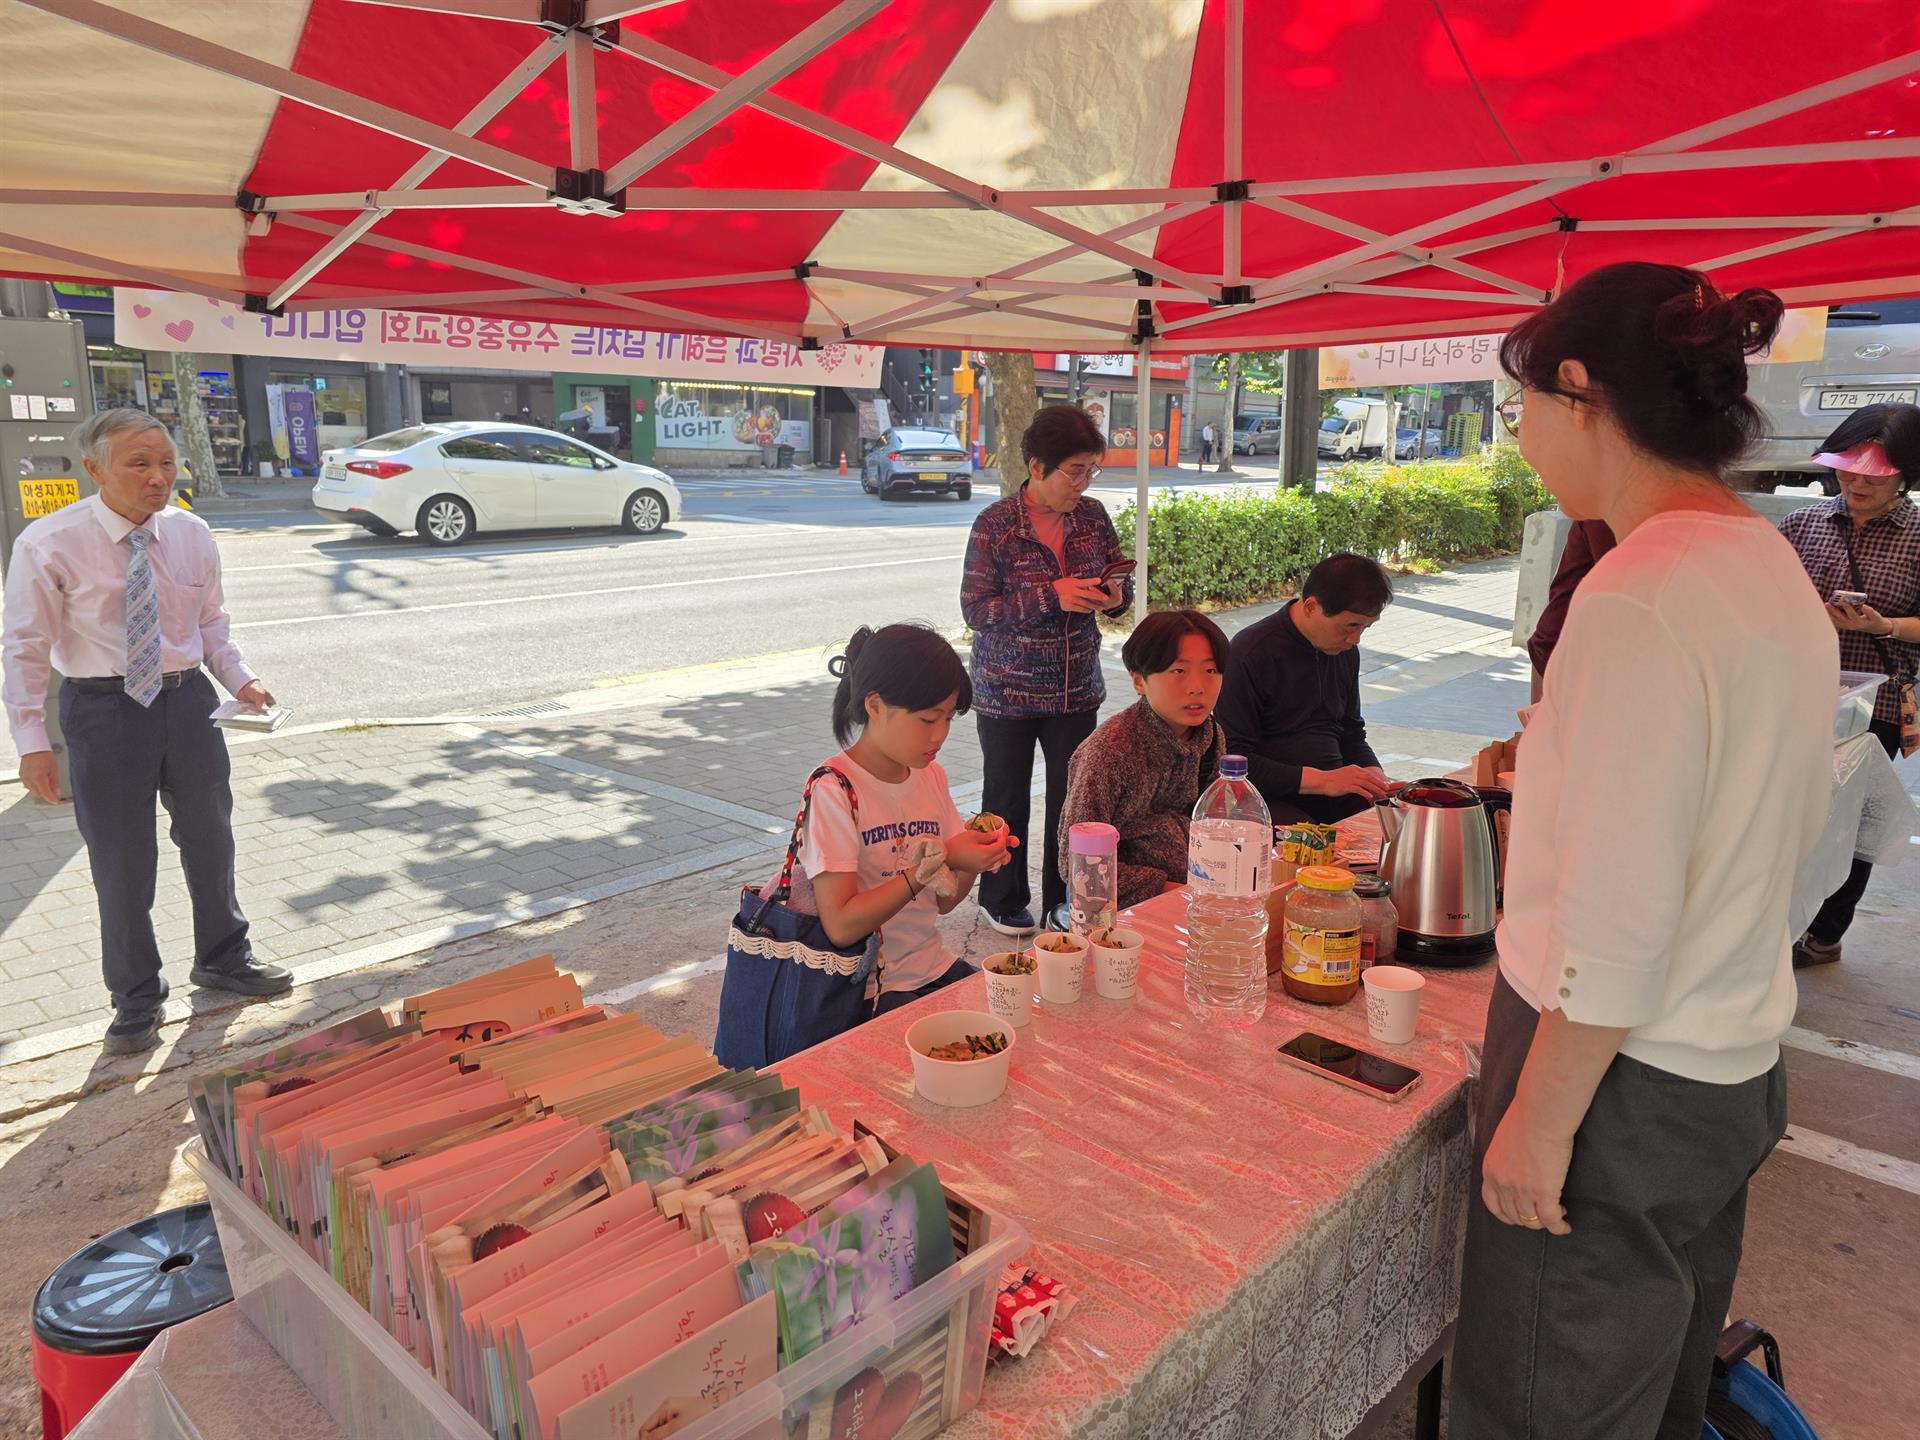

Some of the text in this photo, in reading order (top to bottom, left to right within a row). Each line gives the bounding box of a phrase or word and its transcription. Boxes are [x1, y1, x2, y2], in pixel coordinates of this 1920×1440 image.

[1830, 393, 1858, 406] 77라
[861, 822, 907, 847] VERITAS
[1446, 912, 1471, 921] Tefal
